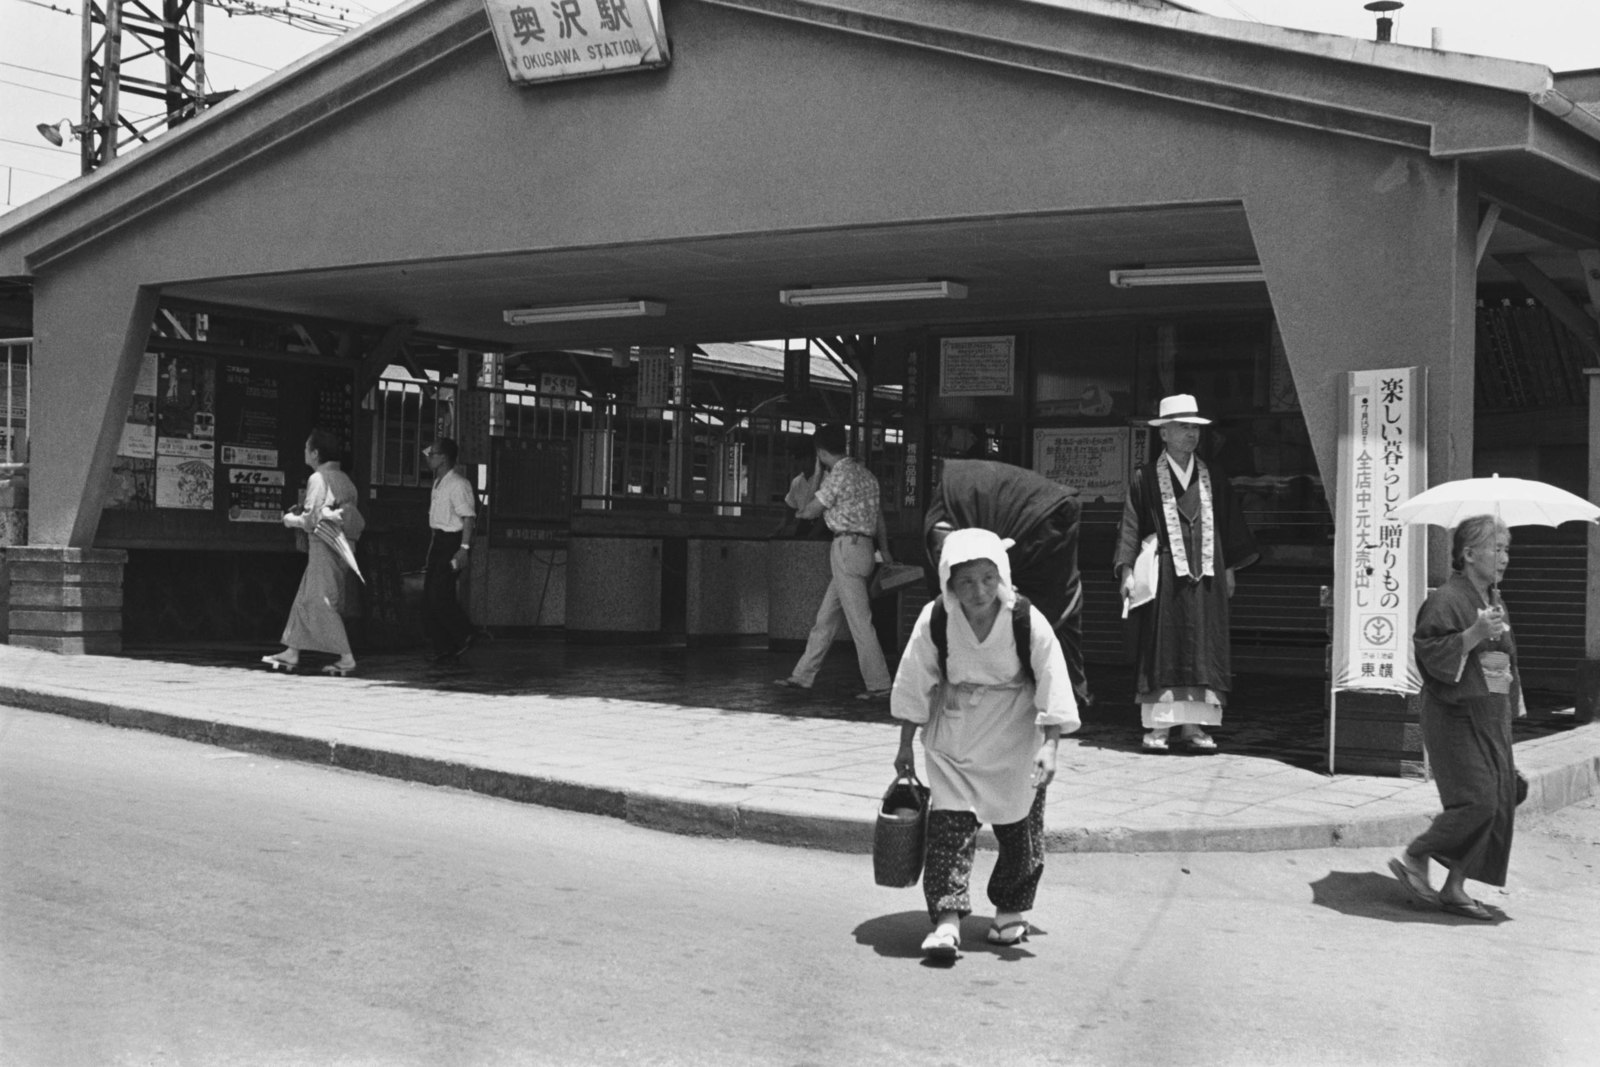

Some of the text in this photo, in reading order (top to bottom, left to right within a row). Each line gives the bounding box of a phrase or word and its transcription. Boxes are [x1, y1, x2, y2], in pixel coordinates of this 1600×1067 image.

[510, 0, 632, 45] 奥沢駅
[522, 39, 642, 70] OKUSAWA STATION
[1379, 378, 1403, 608] 楽しい暮らしと贈りもの
[1355, 450, 1373, 607] 全店中元大売出し
[1361, 663, 1394, 678] 東横
